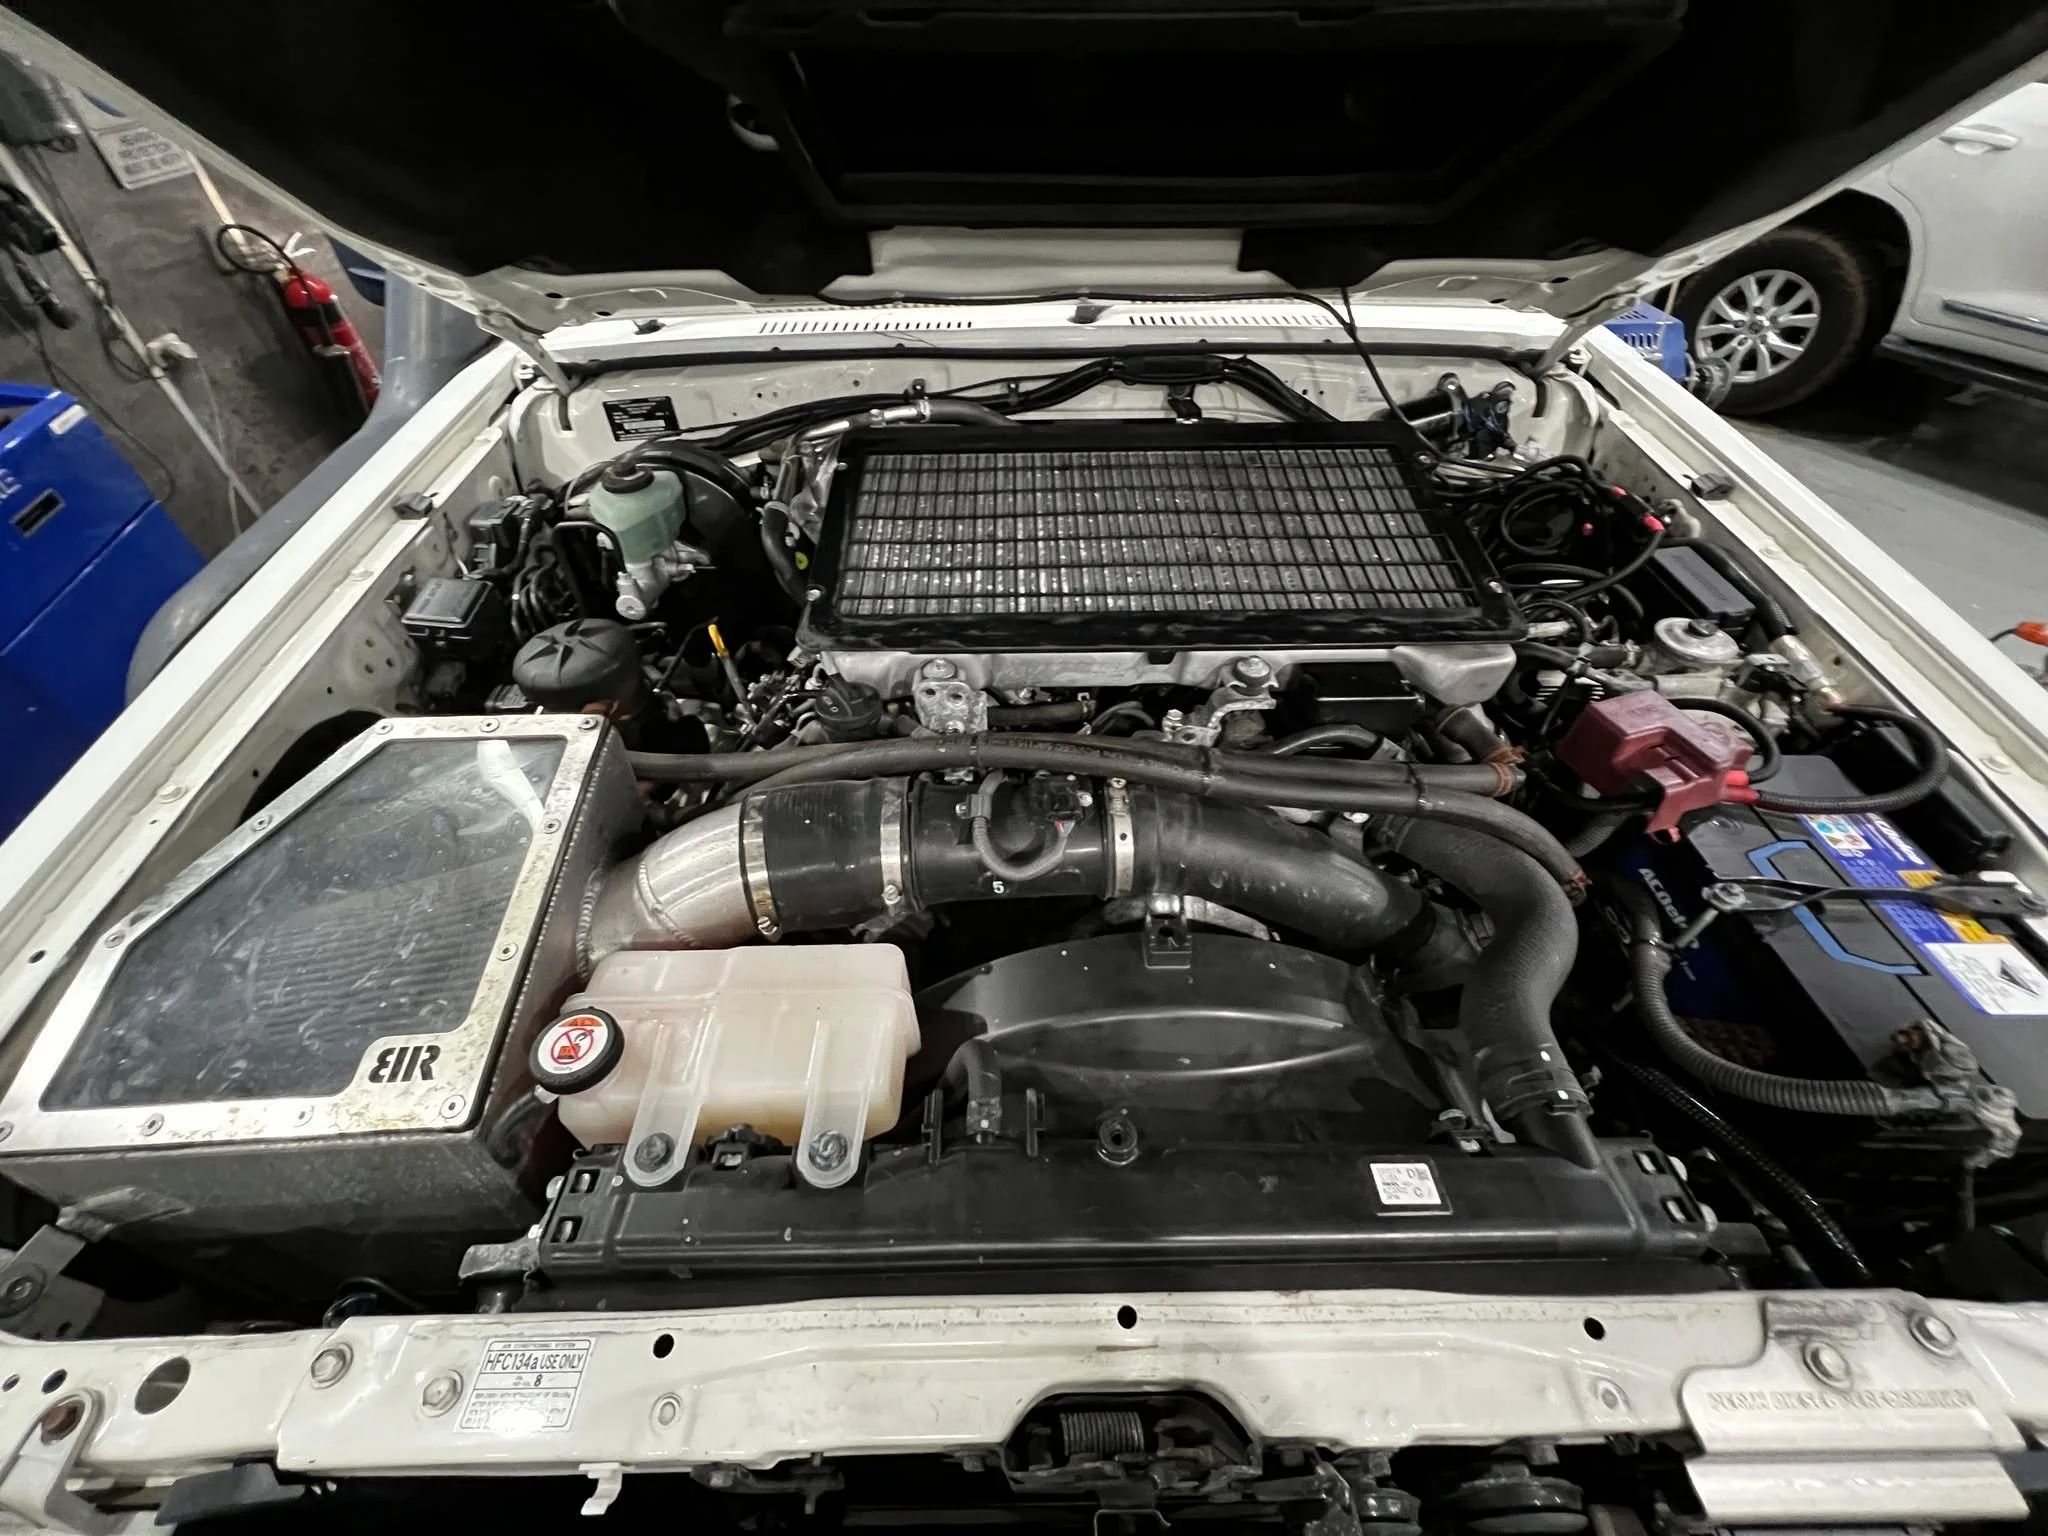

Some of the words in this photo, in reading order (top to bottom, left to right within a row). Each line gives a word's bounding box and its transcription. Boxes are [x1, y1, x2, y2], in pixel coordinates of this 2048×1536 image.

[992, 880, 1005, 894] 5
[1638, 868, 1699, 949] ACDel
[485, 1352, 539, 1370] HFC134a
[540, 1353, 560, 1369] USE
[560, 1353, 584, 1369] ONLY
[534, 1373, 543, 1387] 8
